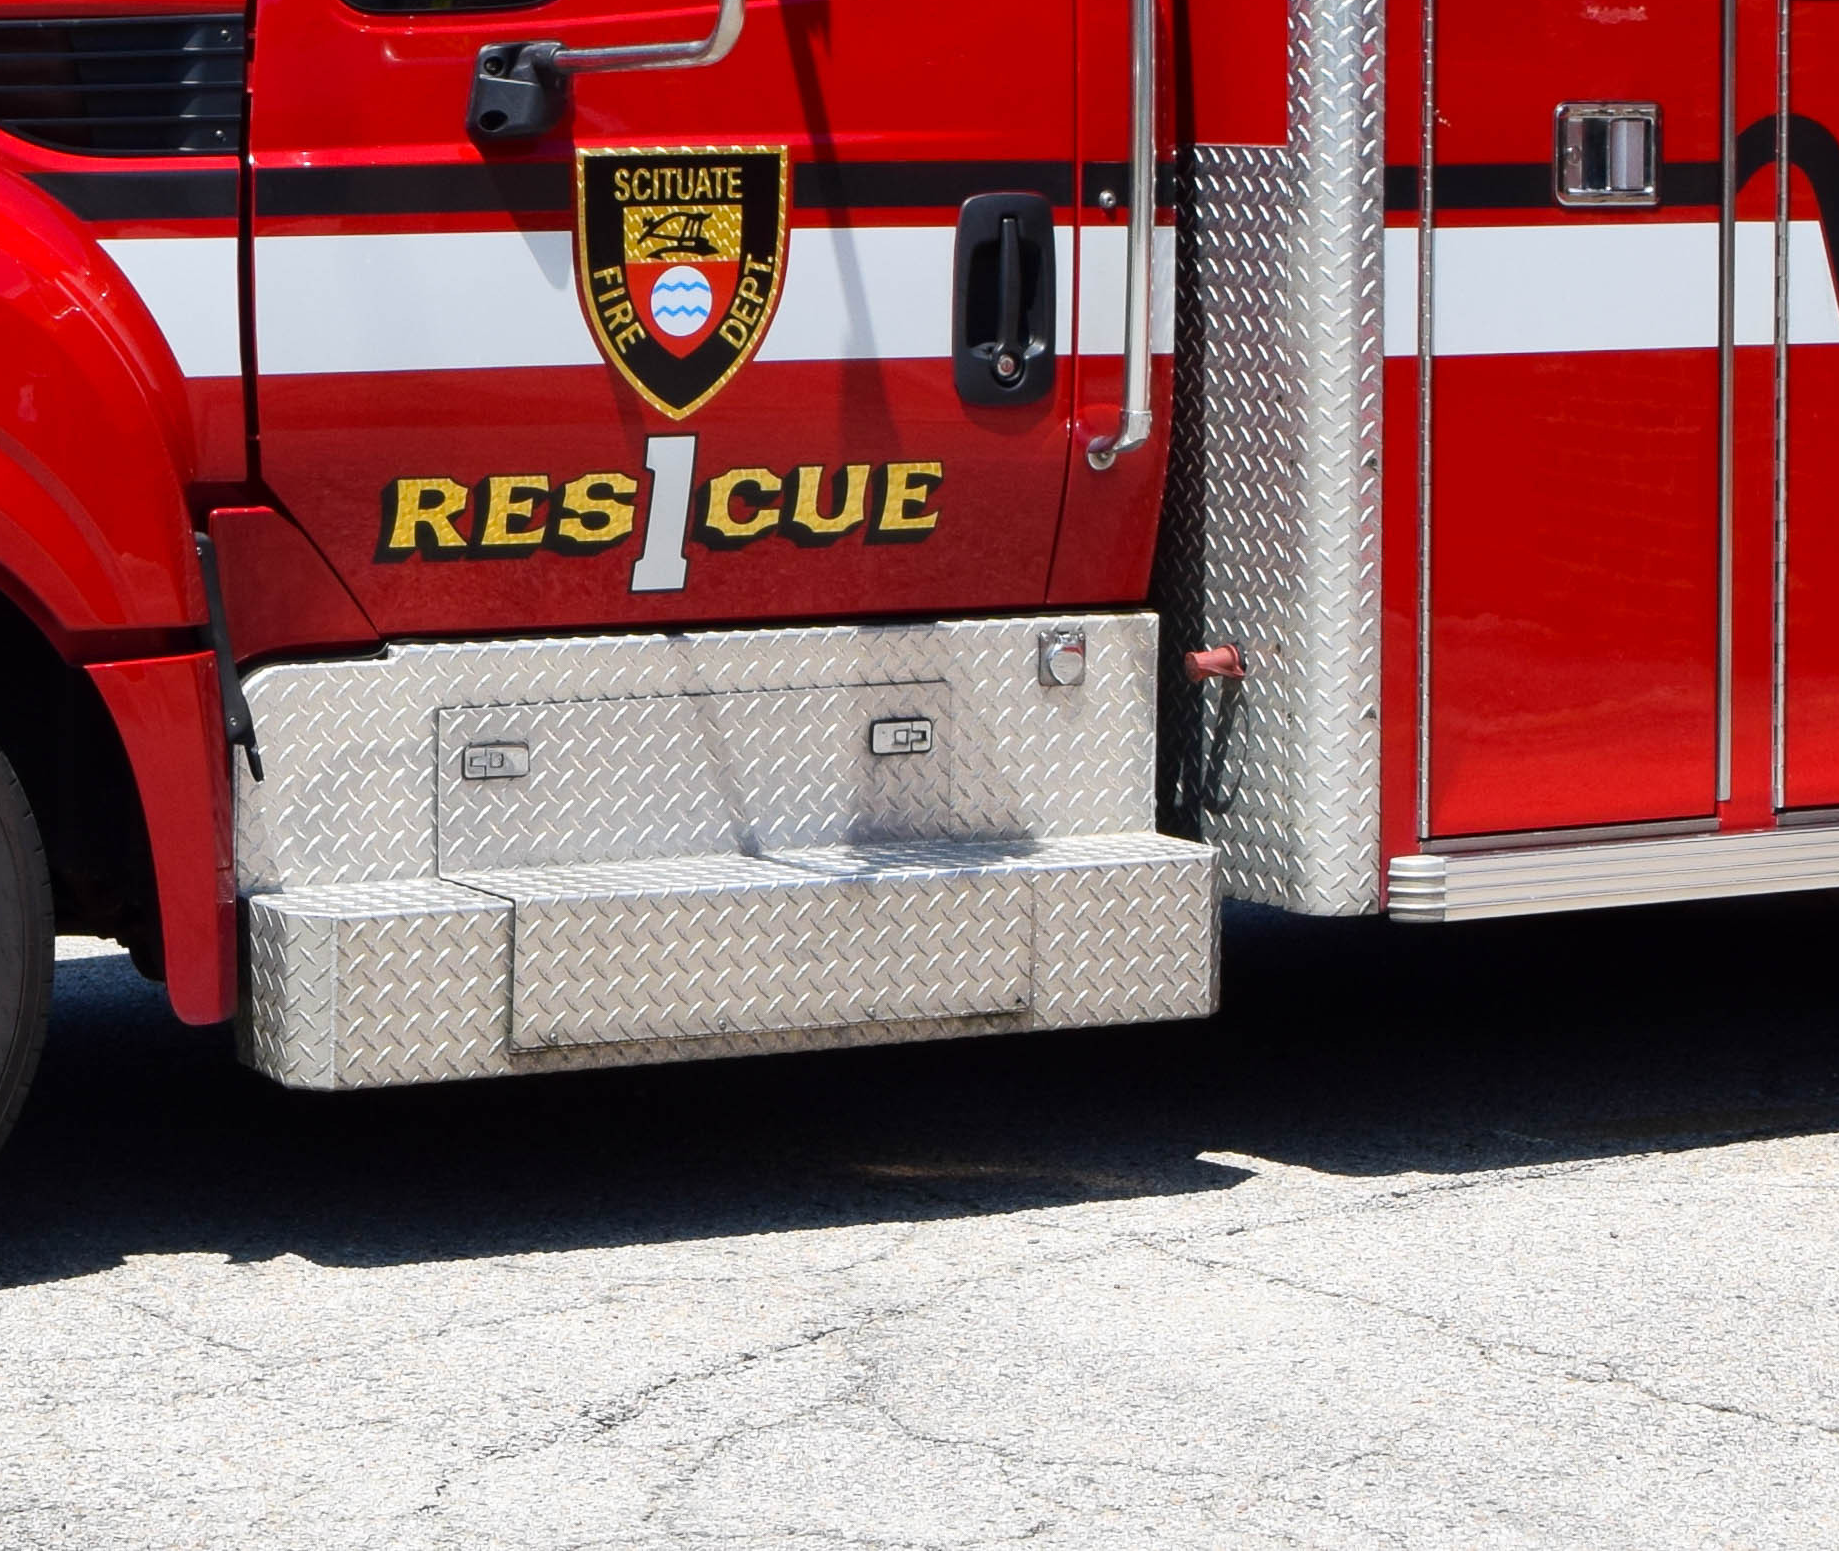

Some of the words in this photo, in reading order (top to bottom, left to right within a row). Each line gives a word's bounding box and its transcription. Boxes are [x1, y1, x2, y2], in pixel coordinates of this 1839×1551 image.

[613, 166, 744, 202] SCITUATE
[593, 264, 647, 354] FIRE
[718, 252, 775, 350] DEPT.
